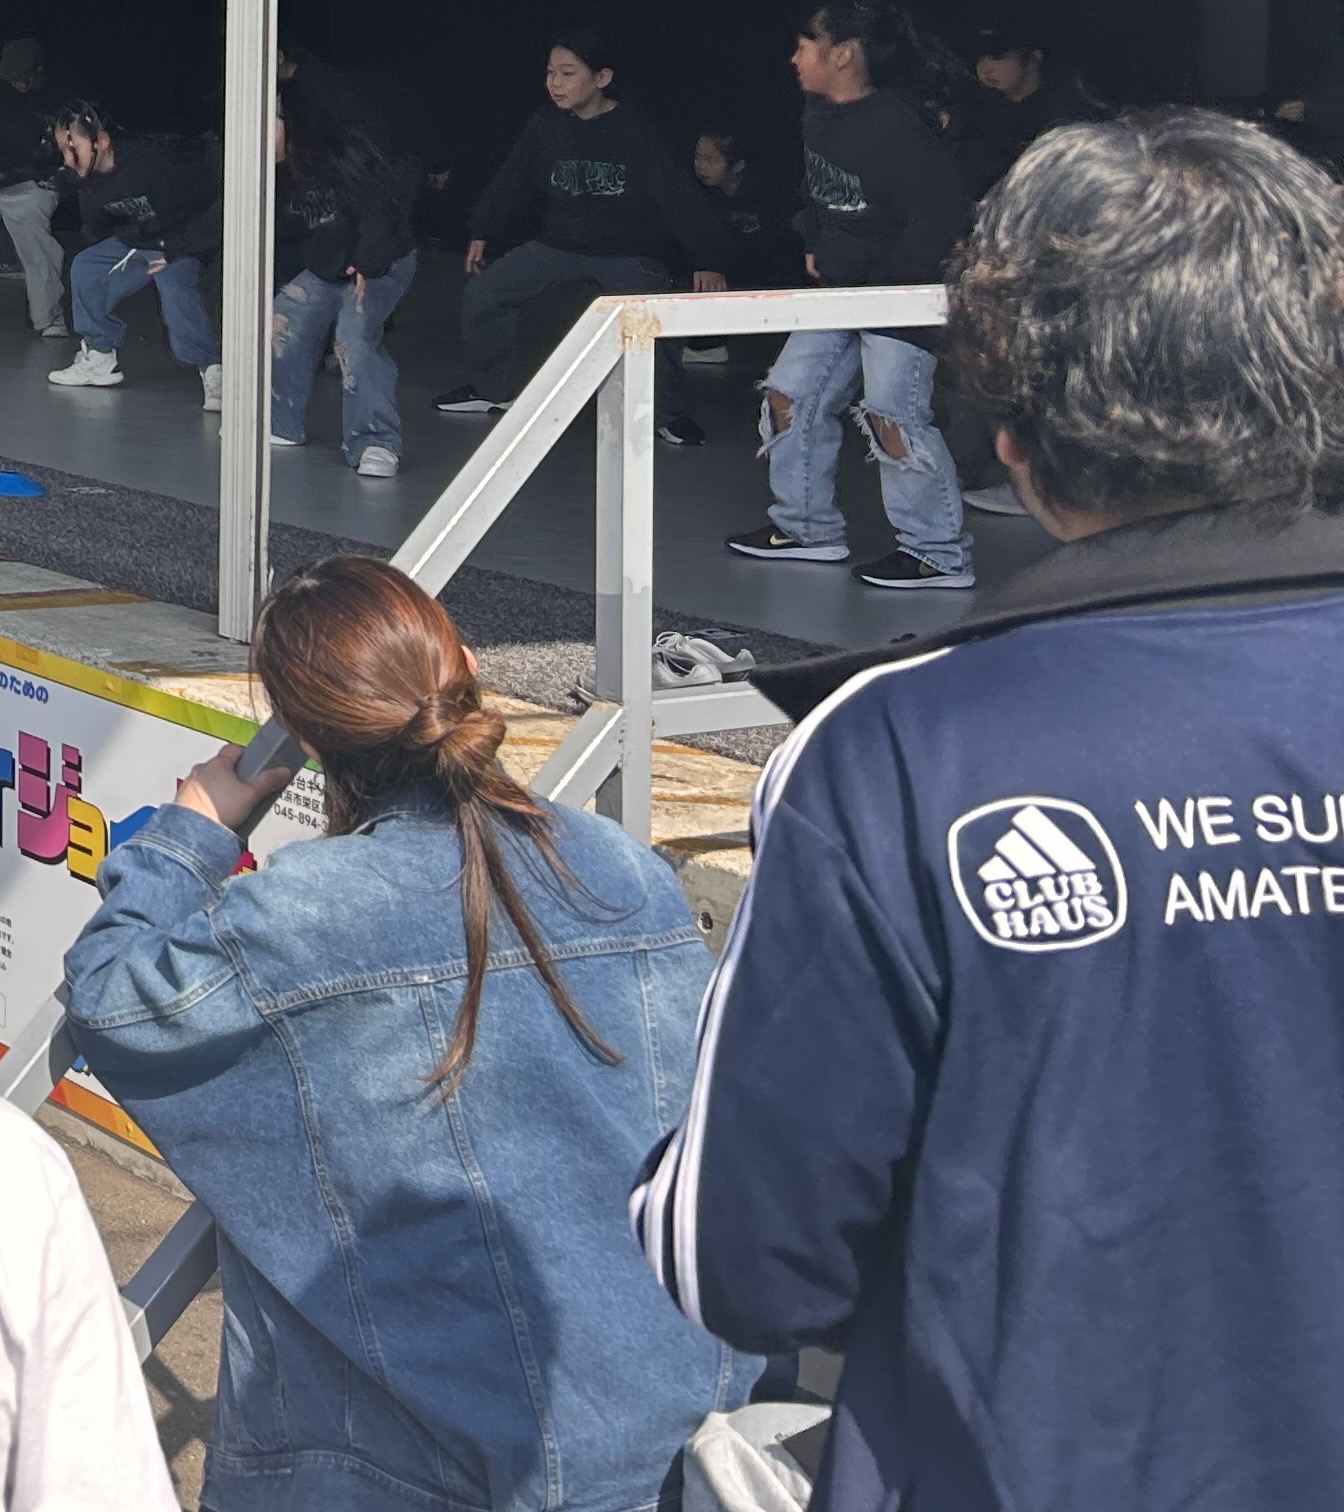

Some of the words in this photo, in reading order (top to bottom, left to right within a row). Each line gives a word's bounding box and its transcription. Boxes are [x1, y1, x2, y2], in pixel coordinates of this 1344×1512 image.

[1134, 796, 1241, 851] WE
[1251, 792, 1344, 844] SU
[983, 872, 1104, 911] CLUB
[992, 895, 1115, 939] HAUS
